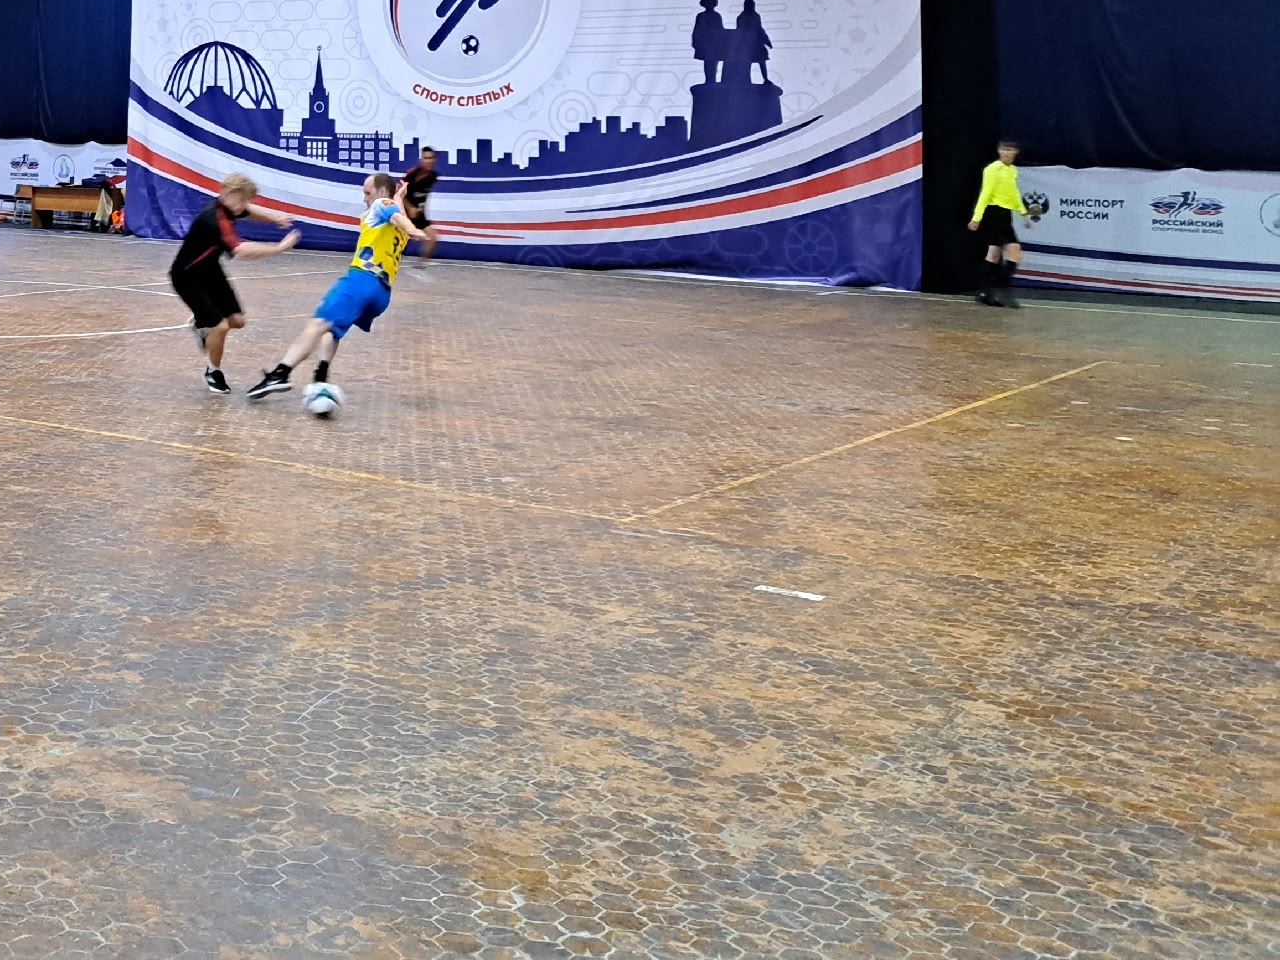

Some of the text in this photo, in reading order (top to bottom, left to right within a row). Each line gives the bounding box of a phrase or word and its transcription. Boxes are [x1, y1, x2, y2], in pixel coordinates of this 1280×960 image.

[412, 82, 515, 107] СПОРТ СЛЕПЫХ
[1059, 197, 1125, 209] МИНСПОРТ
[1059, 210, 1109, 220] РОССИИ
[1152, 218, 1223, 228] РОССИЙСКИЙ
